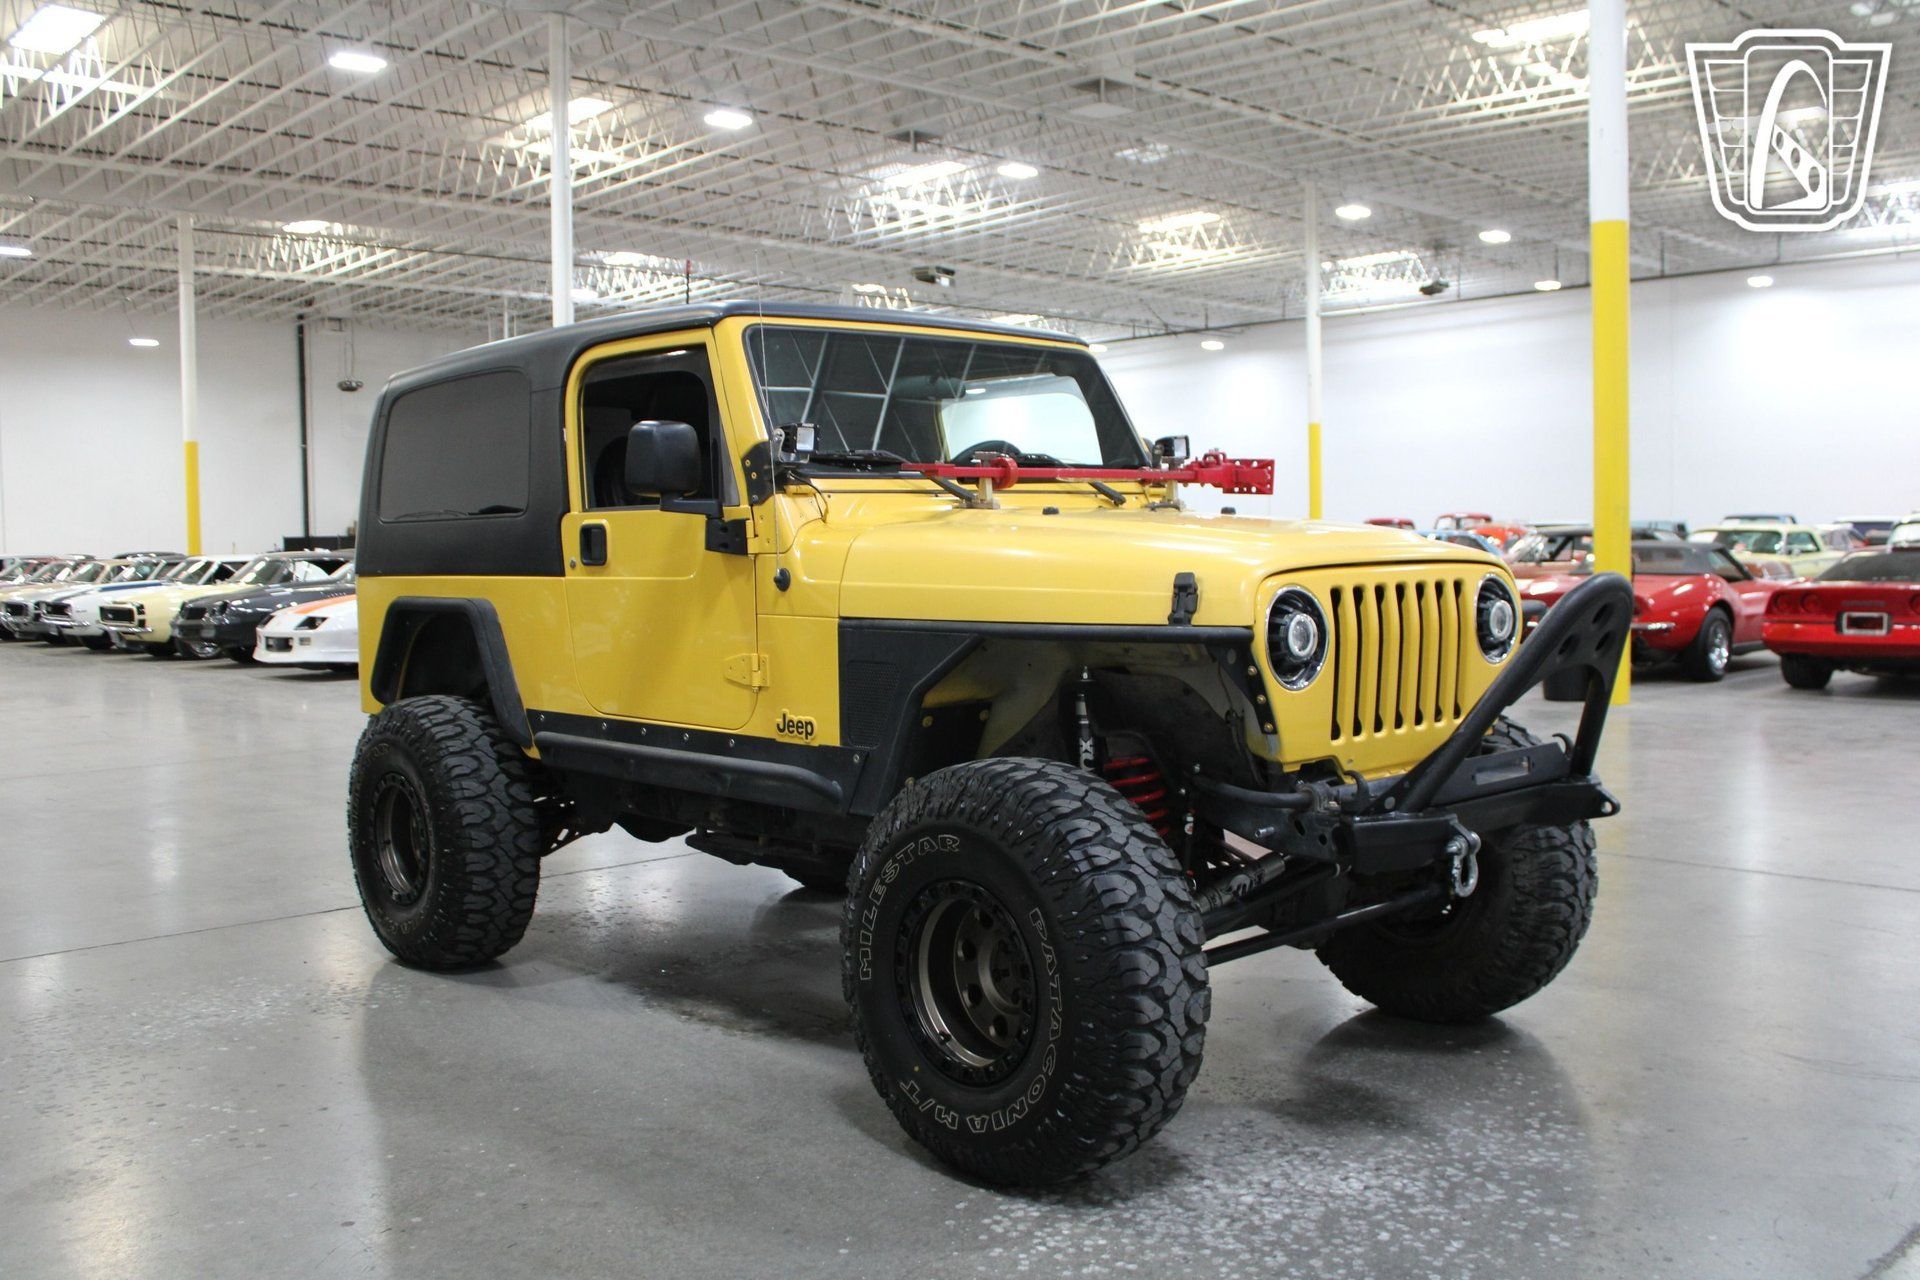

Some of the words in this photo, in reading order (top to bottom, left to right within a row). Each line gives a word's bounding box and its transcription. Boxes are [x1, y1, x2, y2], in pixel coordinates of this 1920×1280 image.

[776, 713, 814, 739] Jeep
[859, 834, 961, 981] MILESTAR
[968, 907, 1064, 1133] PATAGONIA
[900, 1079, 959, 1132] M/T
